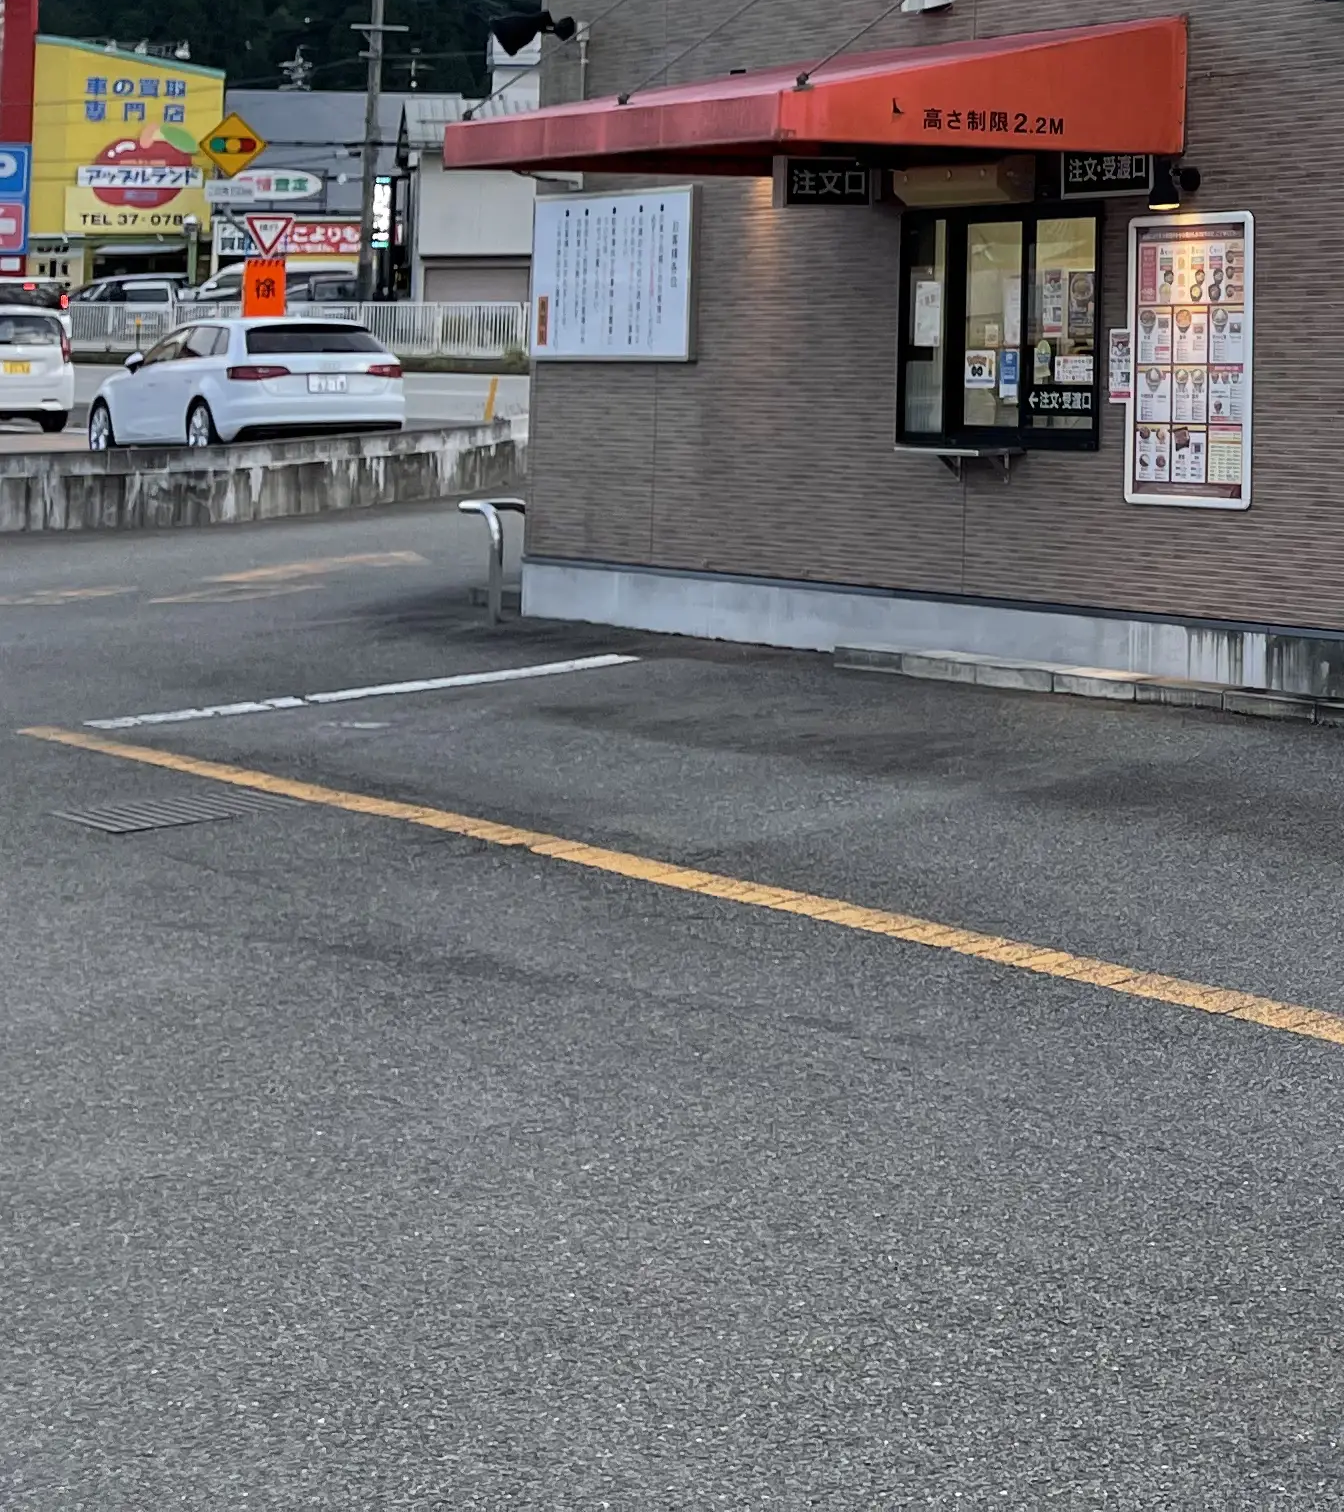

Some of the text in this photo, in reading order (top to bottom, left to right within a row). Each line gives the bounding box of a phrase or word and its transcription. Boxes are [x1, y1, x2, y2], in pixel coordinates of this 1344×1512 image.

[85, 77, 187, 99] 車の買取
[923, 108, 1065, 135] 高さ制限2.2M
[792, 169, 866, 195] 注文口
[80, 213, 189, 226] TEL 37-078
